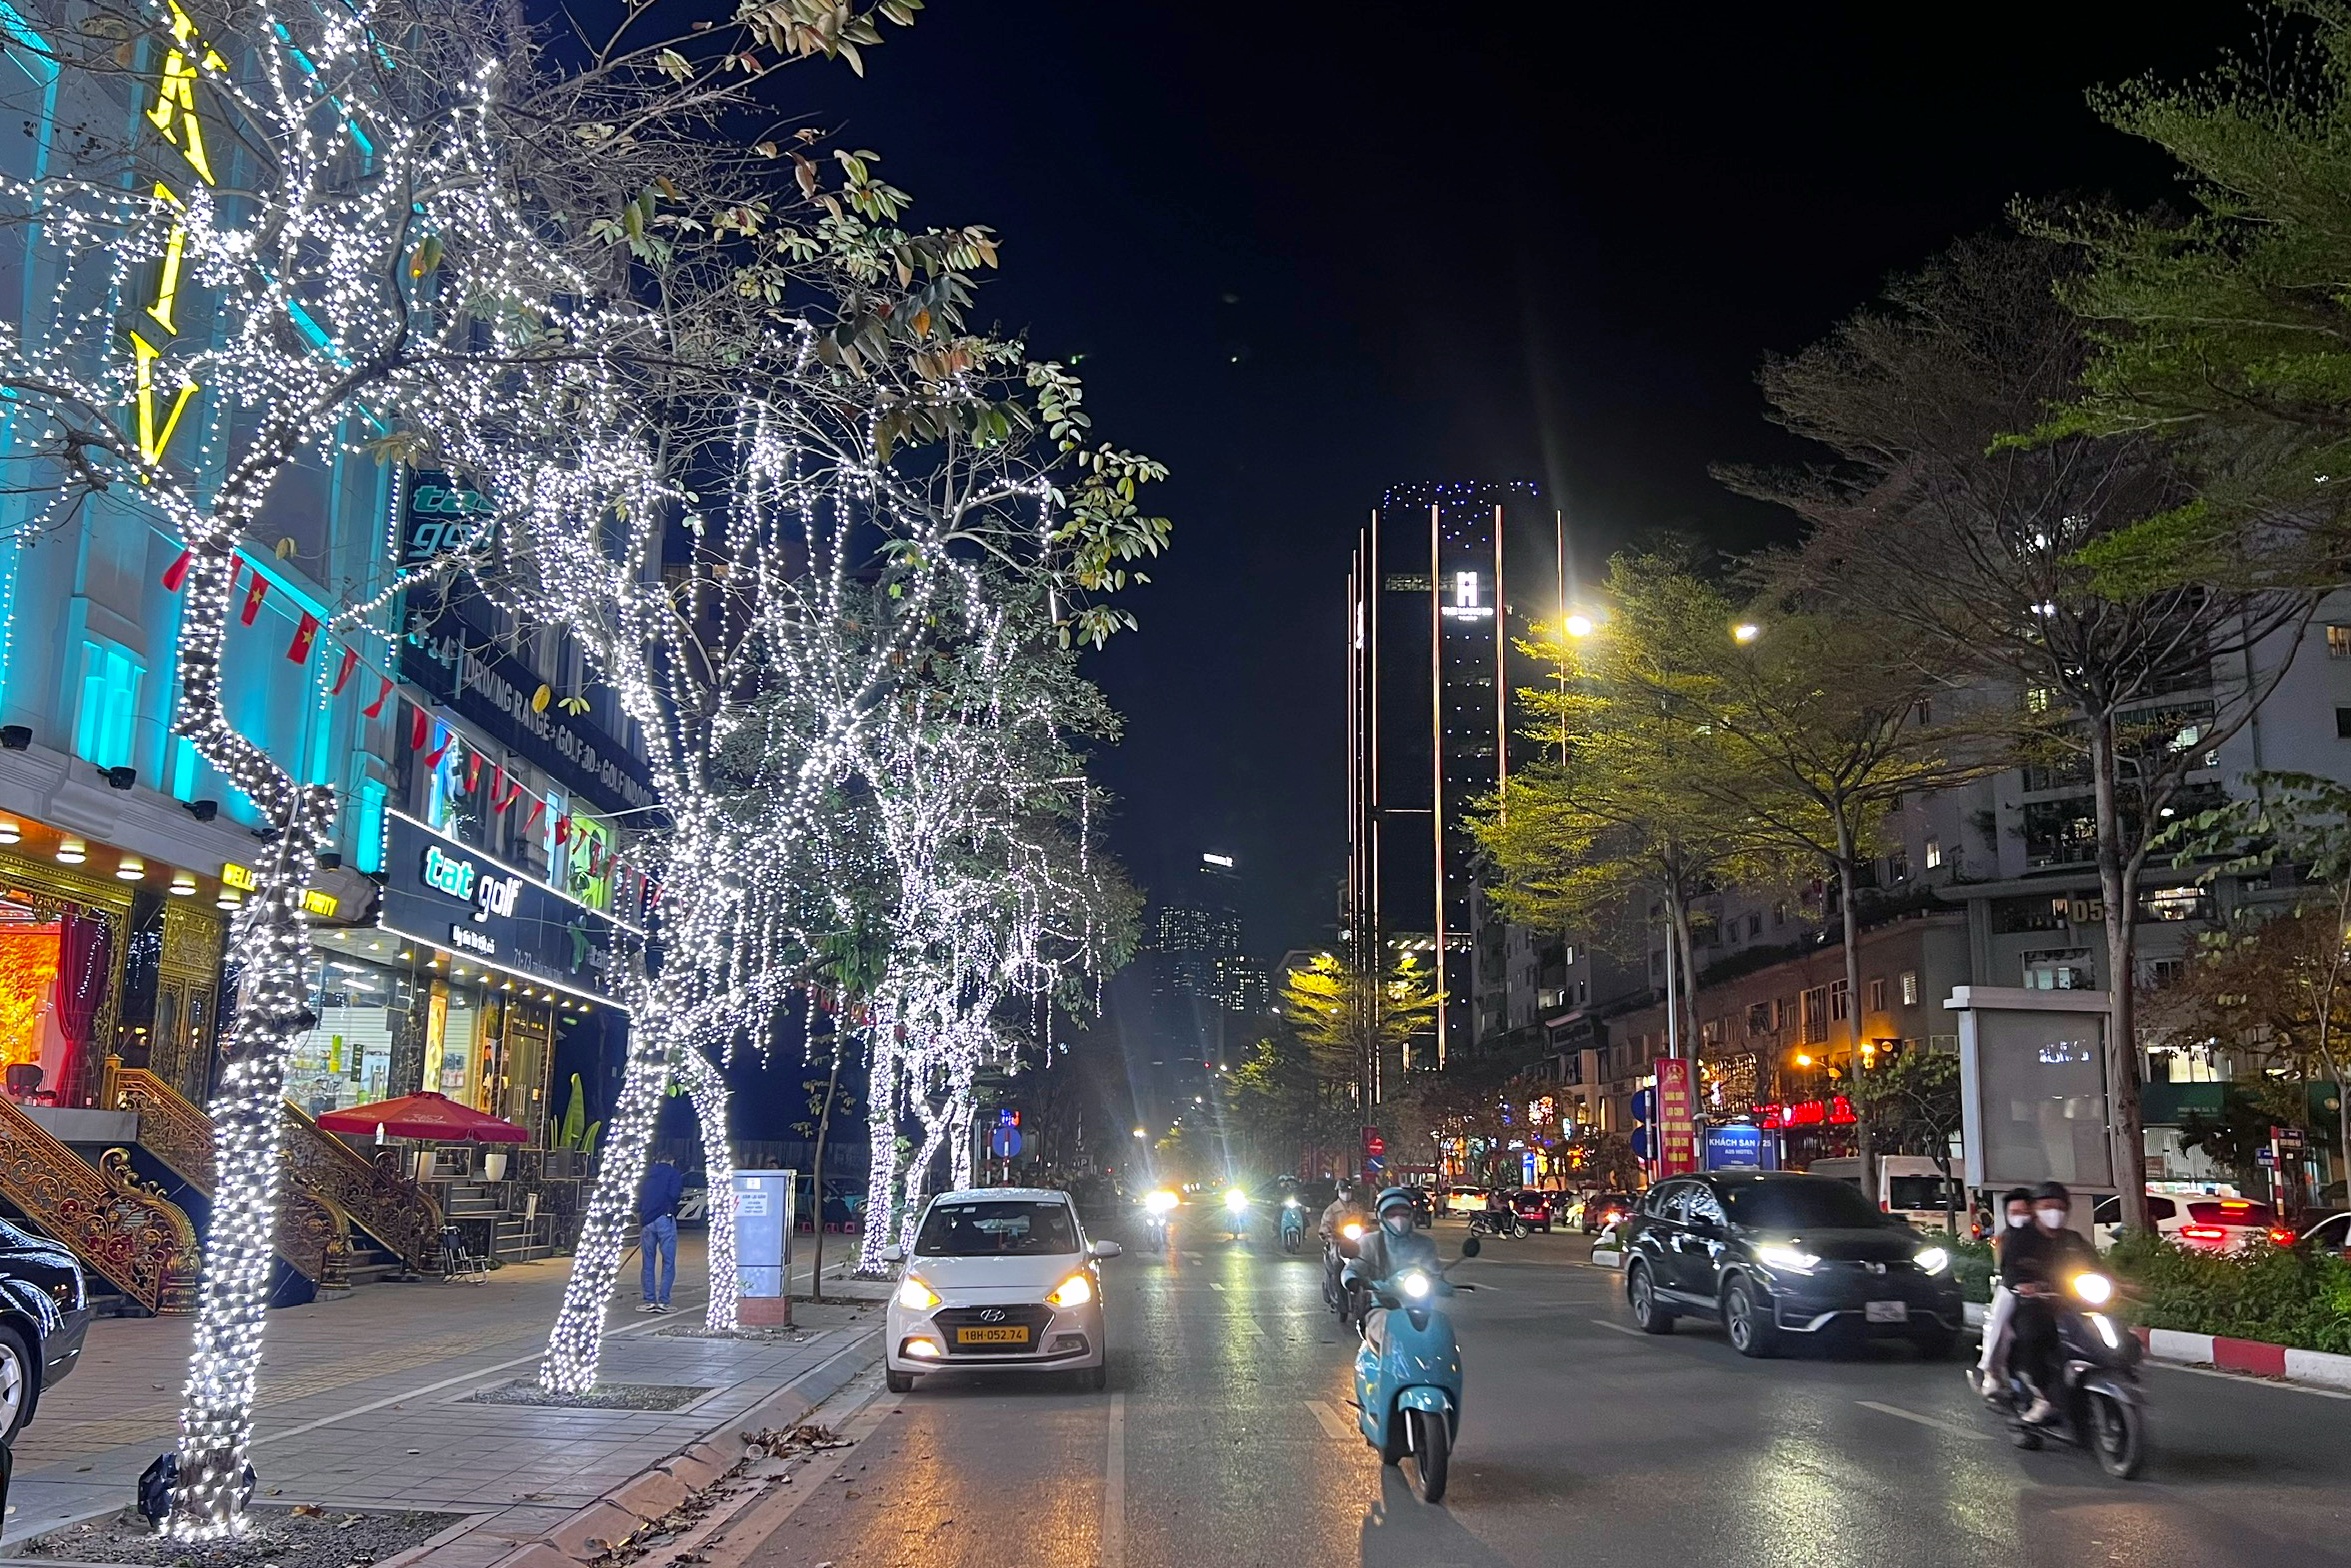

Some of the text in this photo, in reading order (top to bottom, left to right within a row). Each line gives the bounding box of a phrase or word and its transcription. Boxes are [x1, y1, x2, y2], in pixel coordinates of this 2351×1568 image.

[463, 652, 513, 712] DRIVING
[556, 724, 583, 763] GOLF
[581, 744, 596, 773] 3D
[600, 759, 624, 794] GOLF
[425, 845, 521, 923] tat golf
[1709, 1137, 1737, 1147] KHÁCH
